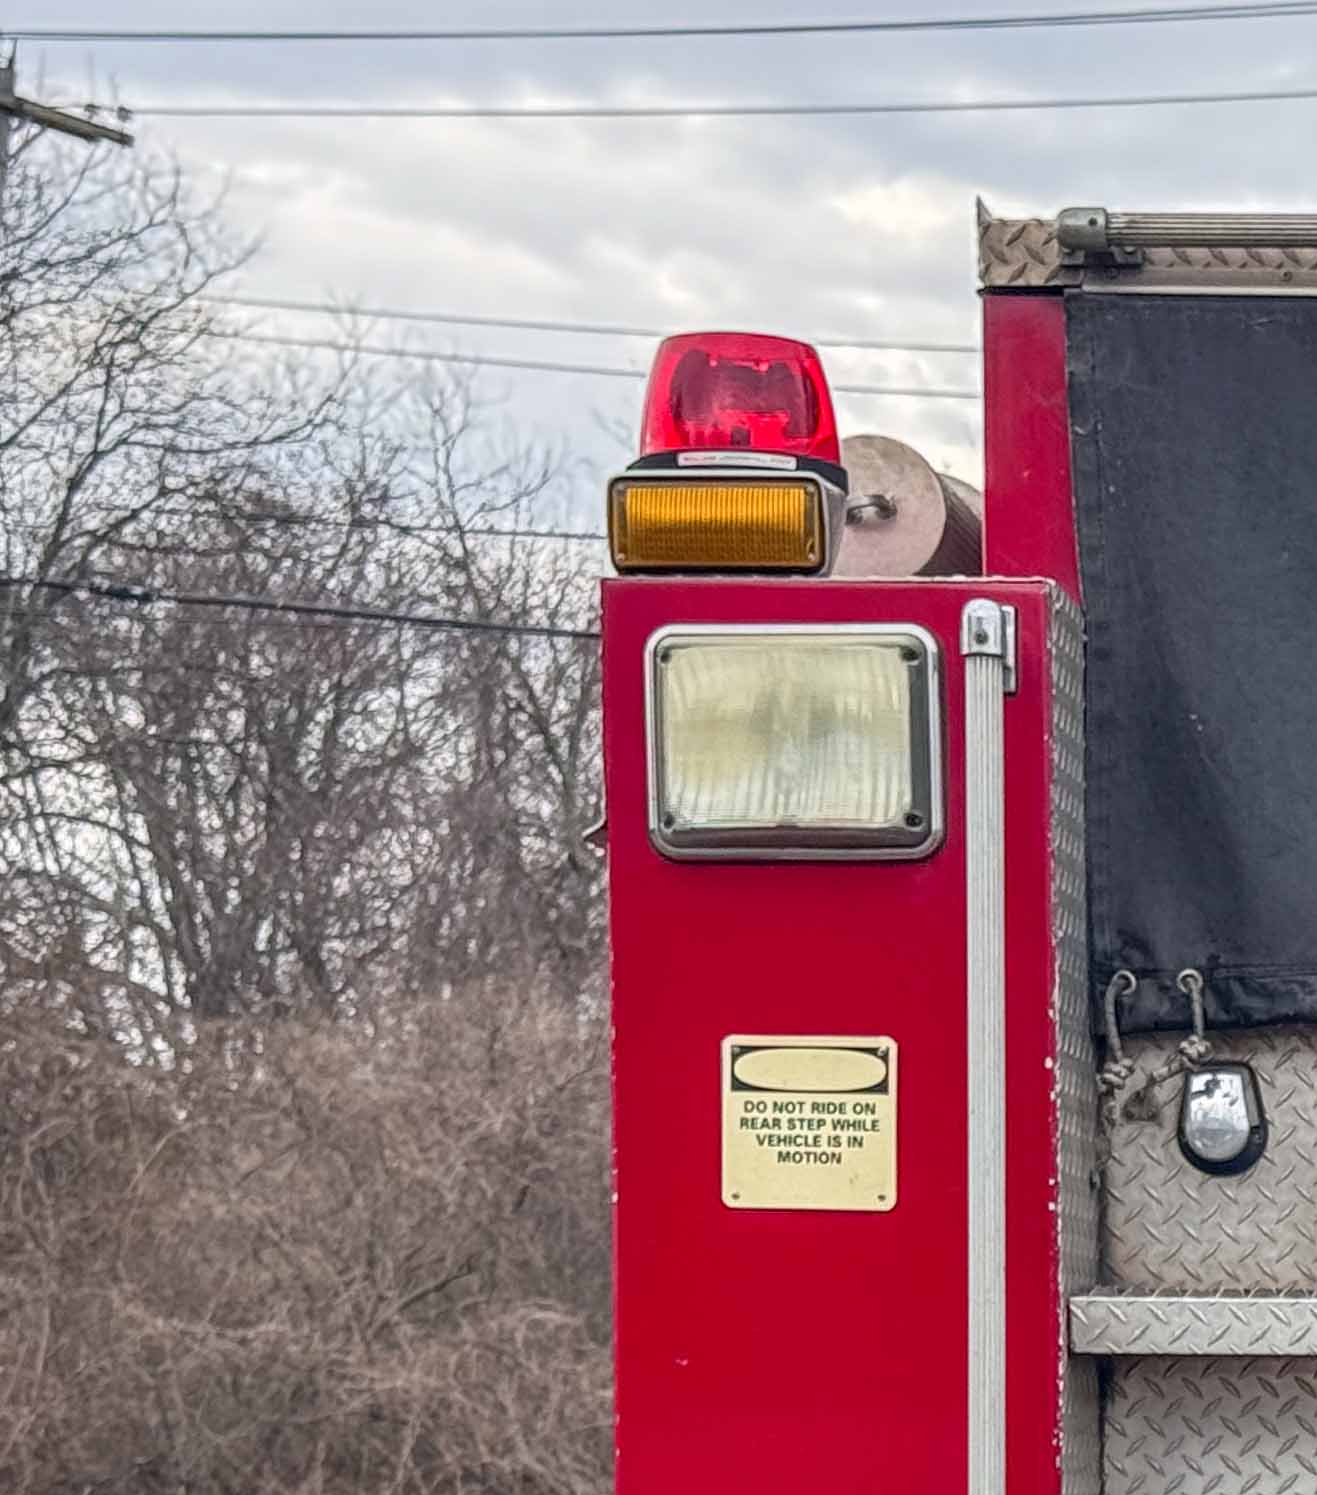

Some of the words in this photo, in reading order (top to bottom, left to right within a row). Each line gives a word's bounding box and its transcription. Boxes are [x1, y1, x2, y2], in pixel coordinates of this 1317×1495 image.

[743, 1100, 767, 1114] DO
[772, 1101, 805, 1115] NOT
[811, 1102, 846, 1115] RIDE
[852, 1102, 876, 1115] ON
[740, 1117, 782, 1130] REAR
[787, 1118, 826, 1131] STEP
[831, 1119, 880, 1132] WHILE
[756, 1134, 821, 1148] VEHICLE
[827, 1135, 842, 1148] IS
[847, 1136, 863, 1148] IN
[777, 1151, 842, 1164] MOTION
